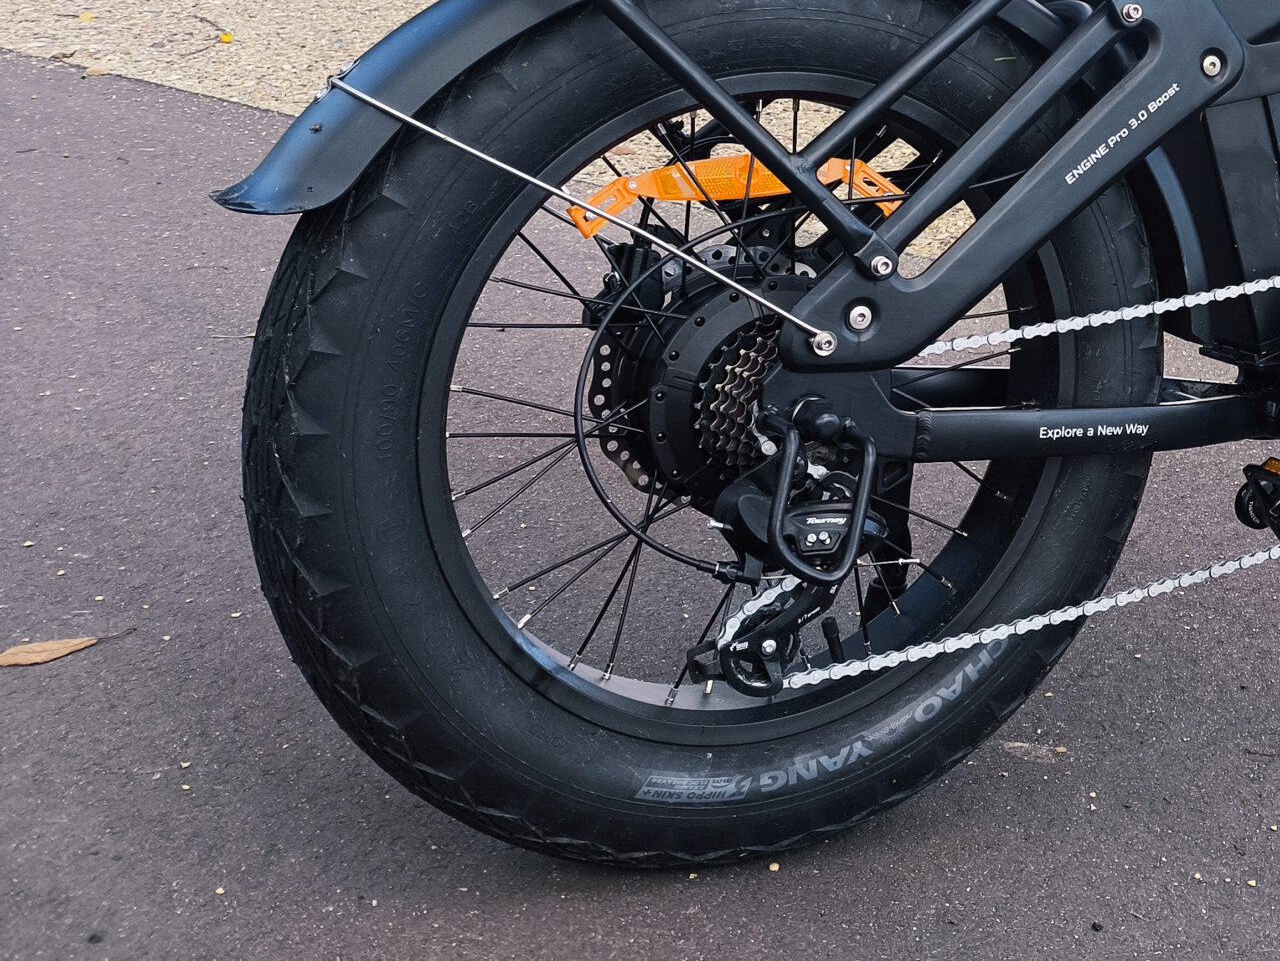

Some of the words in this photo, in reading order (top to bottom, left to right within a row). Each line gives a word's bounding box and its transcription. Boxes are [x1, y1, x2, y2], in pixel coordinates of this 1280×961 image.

[1064, 142, 1110, 185] ENGINE
[1107, 127, 1129, 148] Pro
[1127, 109, 1148, 130] 3.0
[1147, 82, 1181, 113] Boost
[1039, 425, 1084, 440] Explore
[1086, 427, 1094, 437] a
[1097, 424, 1124, 436] New
[1125, 423, 1149, 437] Way
[805, 516, 847, 525] Tourney
[914, 641, 1009, 724] CHAO
[759, 742, 873, 793] YANG
[686, 790, 727, 800] HIPPO
